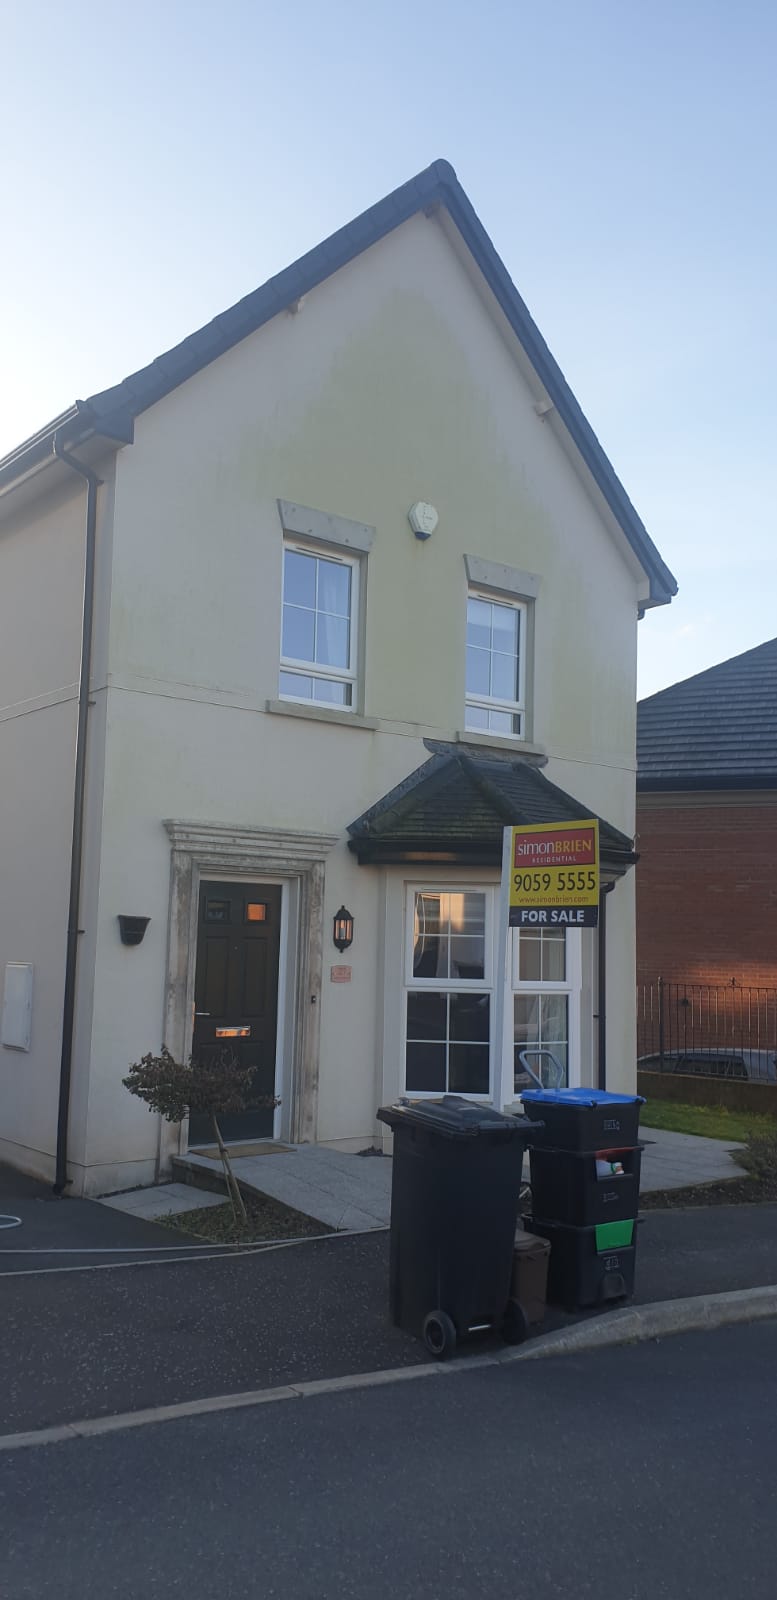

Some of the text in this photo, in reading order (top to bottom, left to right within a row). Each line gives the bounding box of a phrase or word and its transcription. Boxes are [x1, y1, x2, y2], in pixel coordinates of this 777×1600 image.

[518, 839, 592, 856] simonBRIEN
[514, 872, 595, 892] 9059 5555
[519, 895, 589, 903] www.simonbrien.com
[521, 910, 585, 922] FOR SALE
